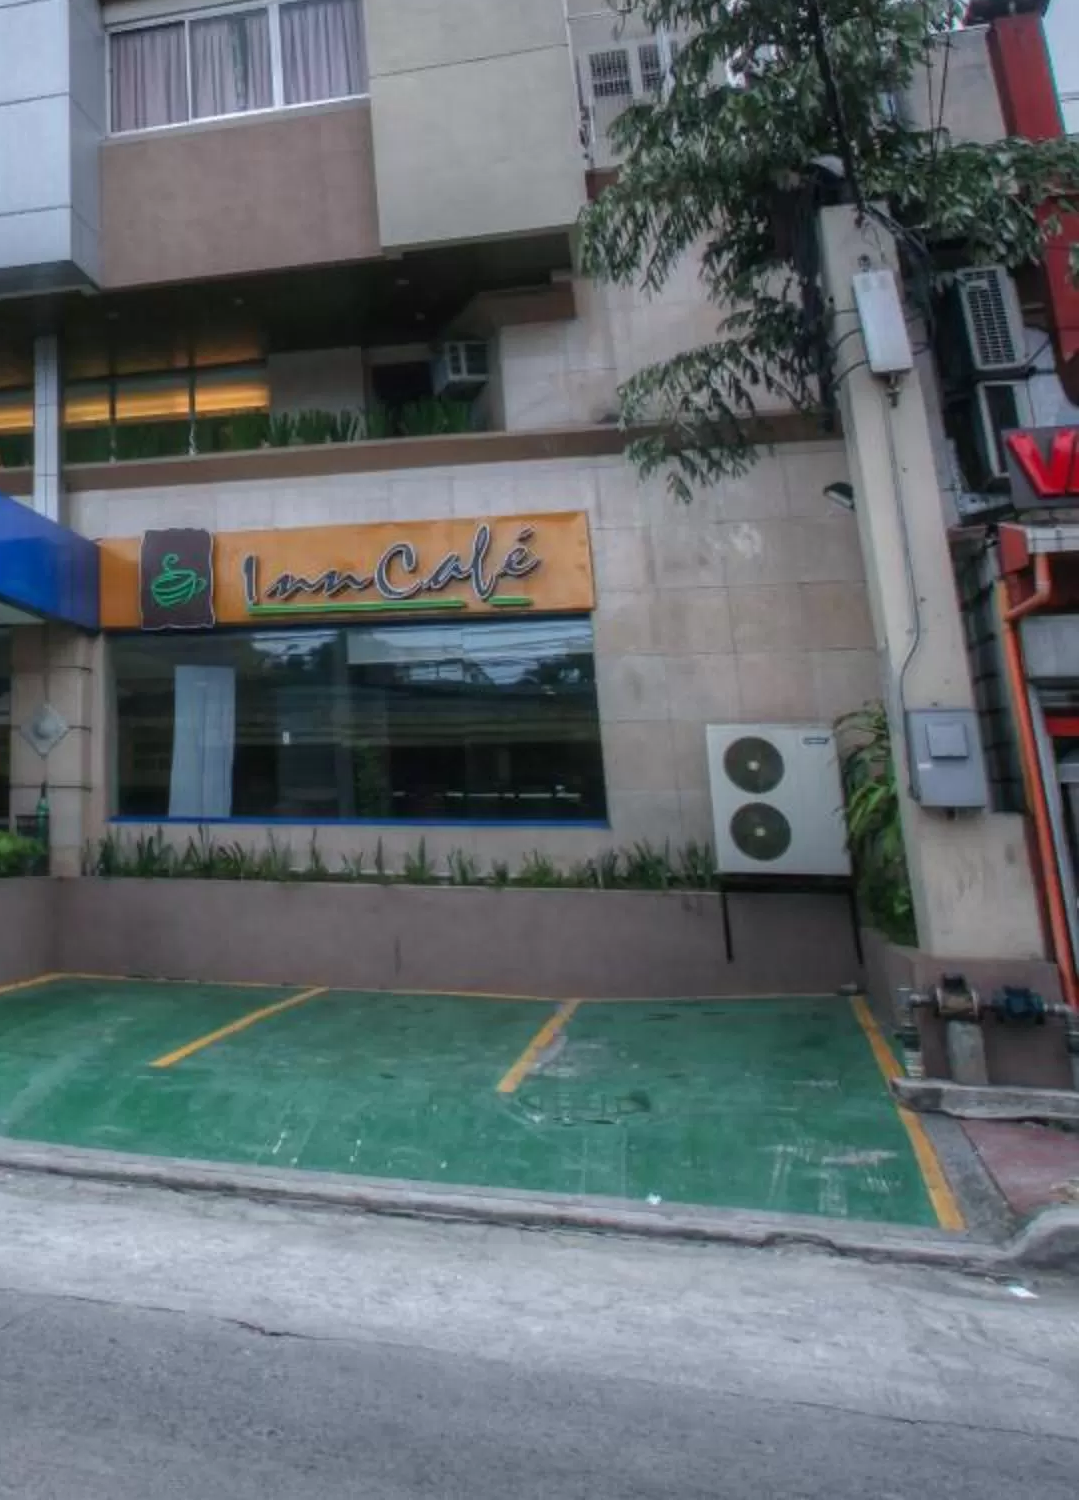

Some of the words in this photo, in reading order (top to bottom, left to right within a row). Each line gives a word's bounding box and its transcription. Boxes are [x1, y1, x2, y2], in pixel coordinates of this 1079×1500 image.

[1006, 427, 1079, 498] V
[241, 553, 372, 606] Inn
[373, 522, 541, 602] Café
